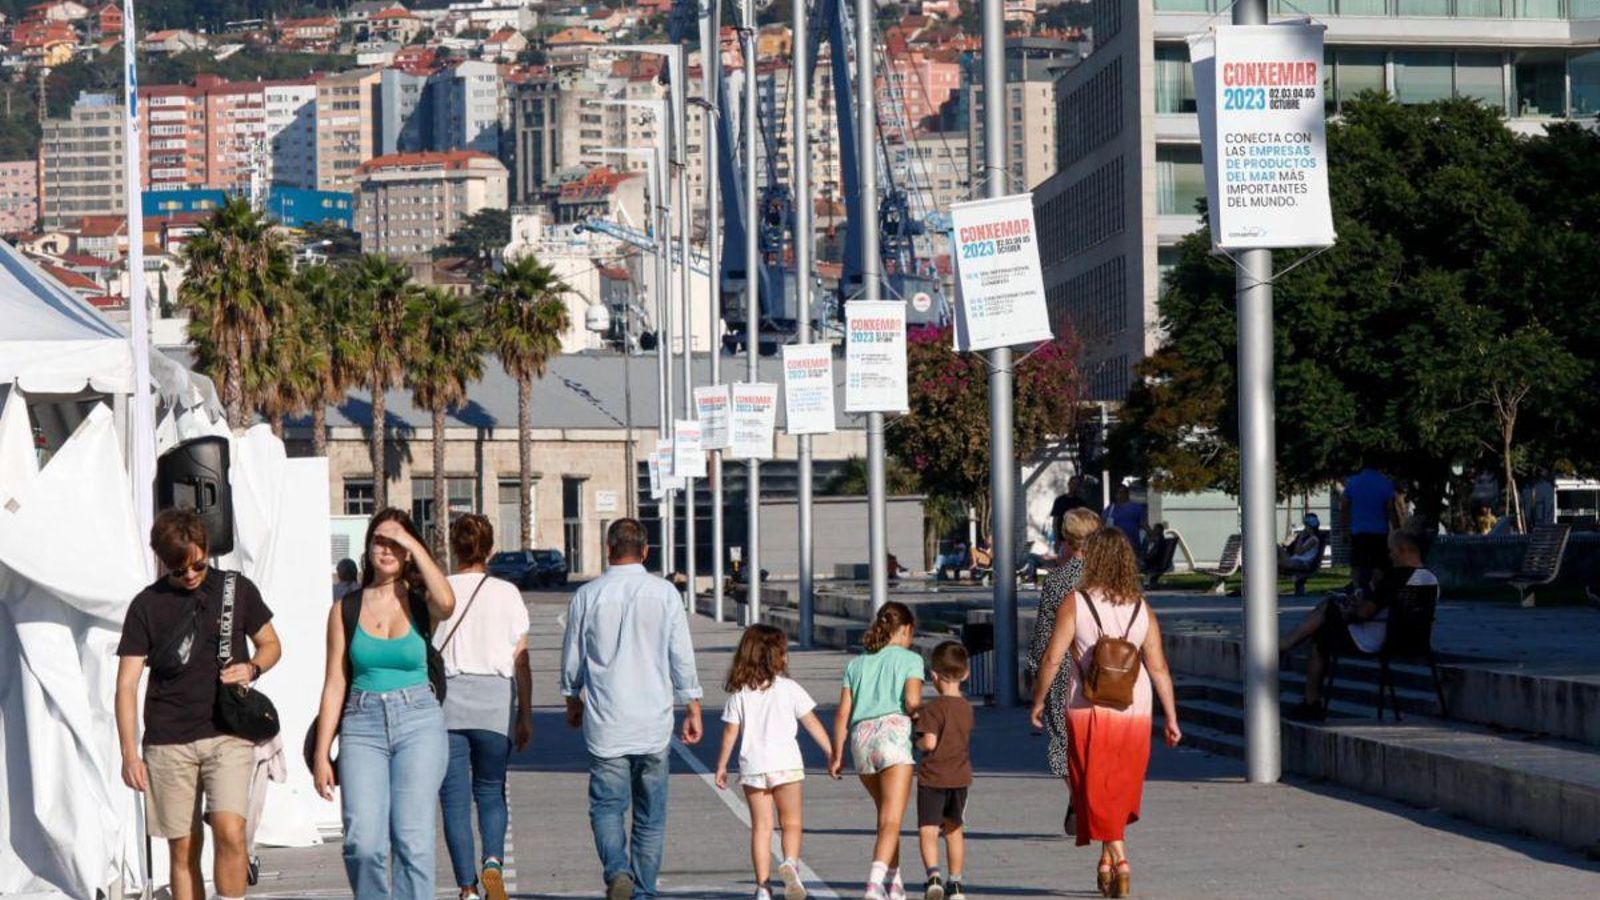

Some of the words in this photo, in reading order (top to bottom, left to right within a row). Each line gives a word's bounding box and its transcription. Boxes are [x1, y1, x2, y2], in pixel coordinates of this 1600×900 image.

[1223, 62, 1316, 86] CONXEMAR
[1224, 88, 1265, 110] 2023
[1269, 88, 1316, 99] 02.03.04.05
[1269, 99, 1300, 110] OCTUBRE
[1225, 132, 1281, 144] CONECTA
[1284, 131, 1312, 144] CON
[1225, 146, 1246, 157] LAS
[1249, 145, 1311, 156] EMPRESAS
[1226, 158, 1241, 169] DE
[1243, 157, 1317, 169] PRODUCTOS
[1226, 171, 1246, 182] DEL
[1249, 171, 1276, 182] MAR
[1279, 168, 1305, 181] MÁS
[1227, 183, 1308, 195] IMPORTANTES
[1227, 196, 1248, 207] DEL
[1250, 196, 1299, 207] MUNDO.
[960, 218, 1030, 243] CONXEMAR
[963, 240, 994, 259] 2023
[851, 332, 874, 343] 2023
